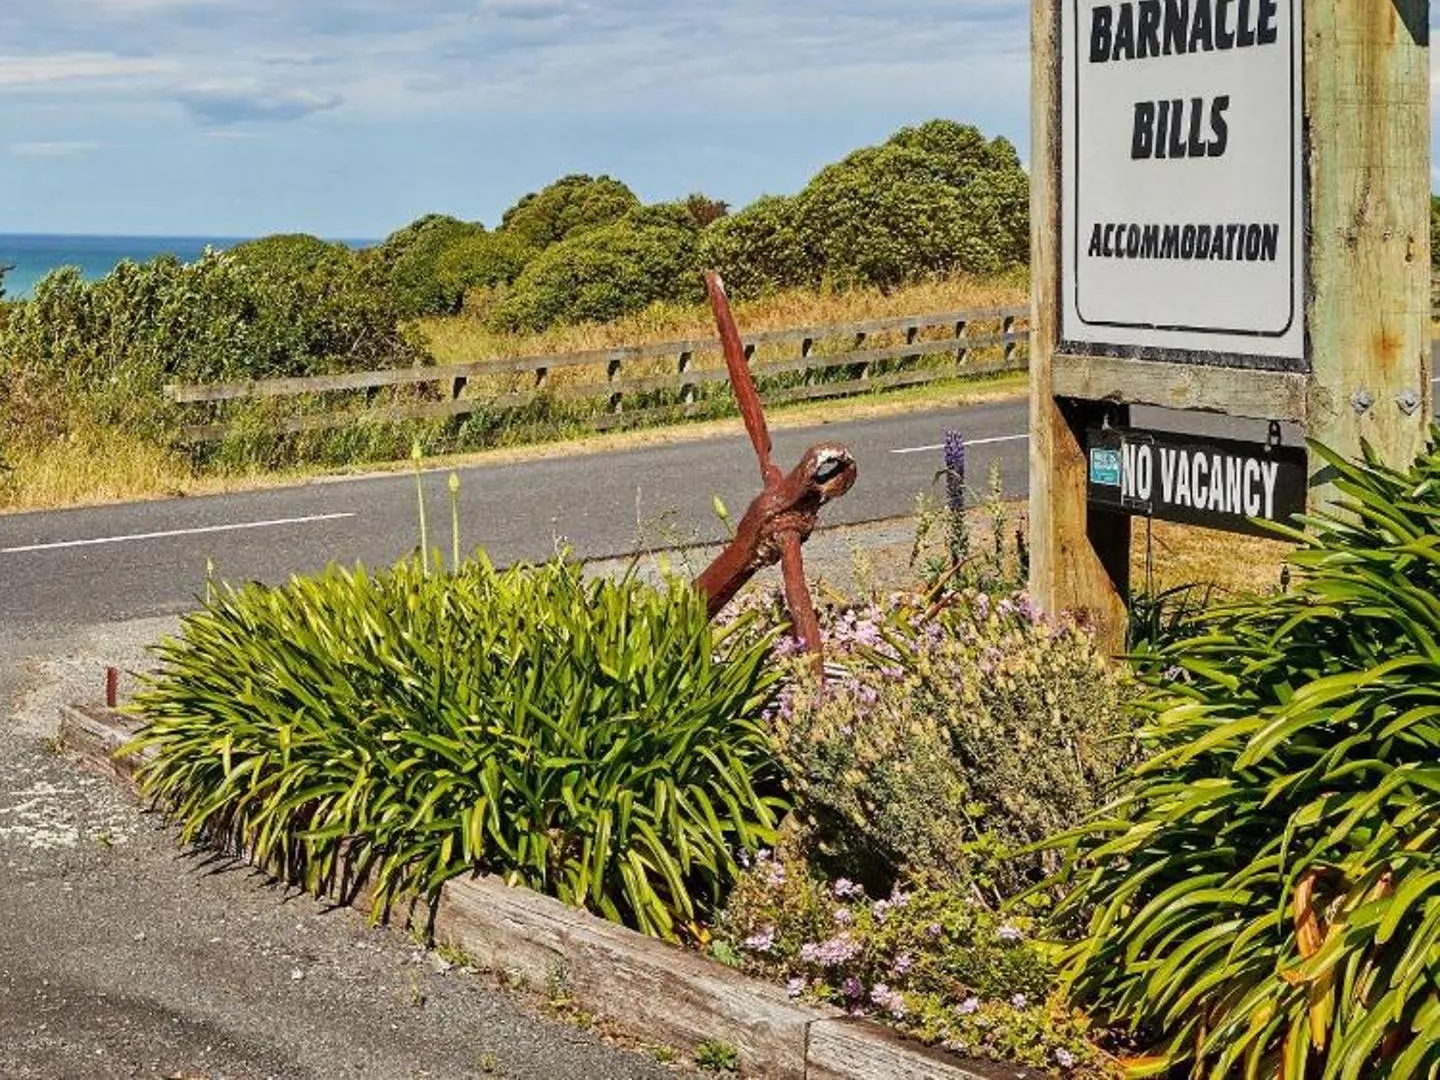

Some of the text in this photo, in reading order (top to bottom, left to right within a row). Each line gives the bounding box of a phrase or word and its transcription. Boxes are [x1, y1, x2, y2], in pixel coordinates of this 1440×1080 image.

[1130, 95, 1230, 160] BILLS
[1088, 223, 1279, 261] ACCOMMODATION
[1122, 442, 1153, 500] NO
[1160, 448, 1279, 519] VACANCY
